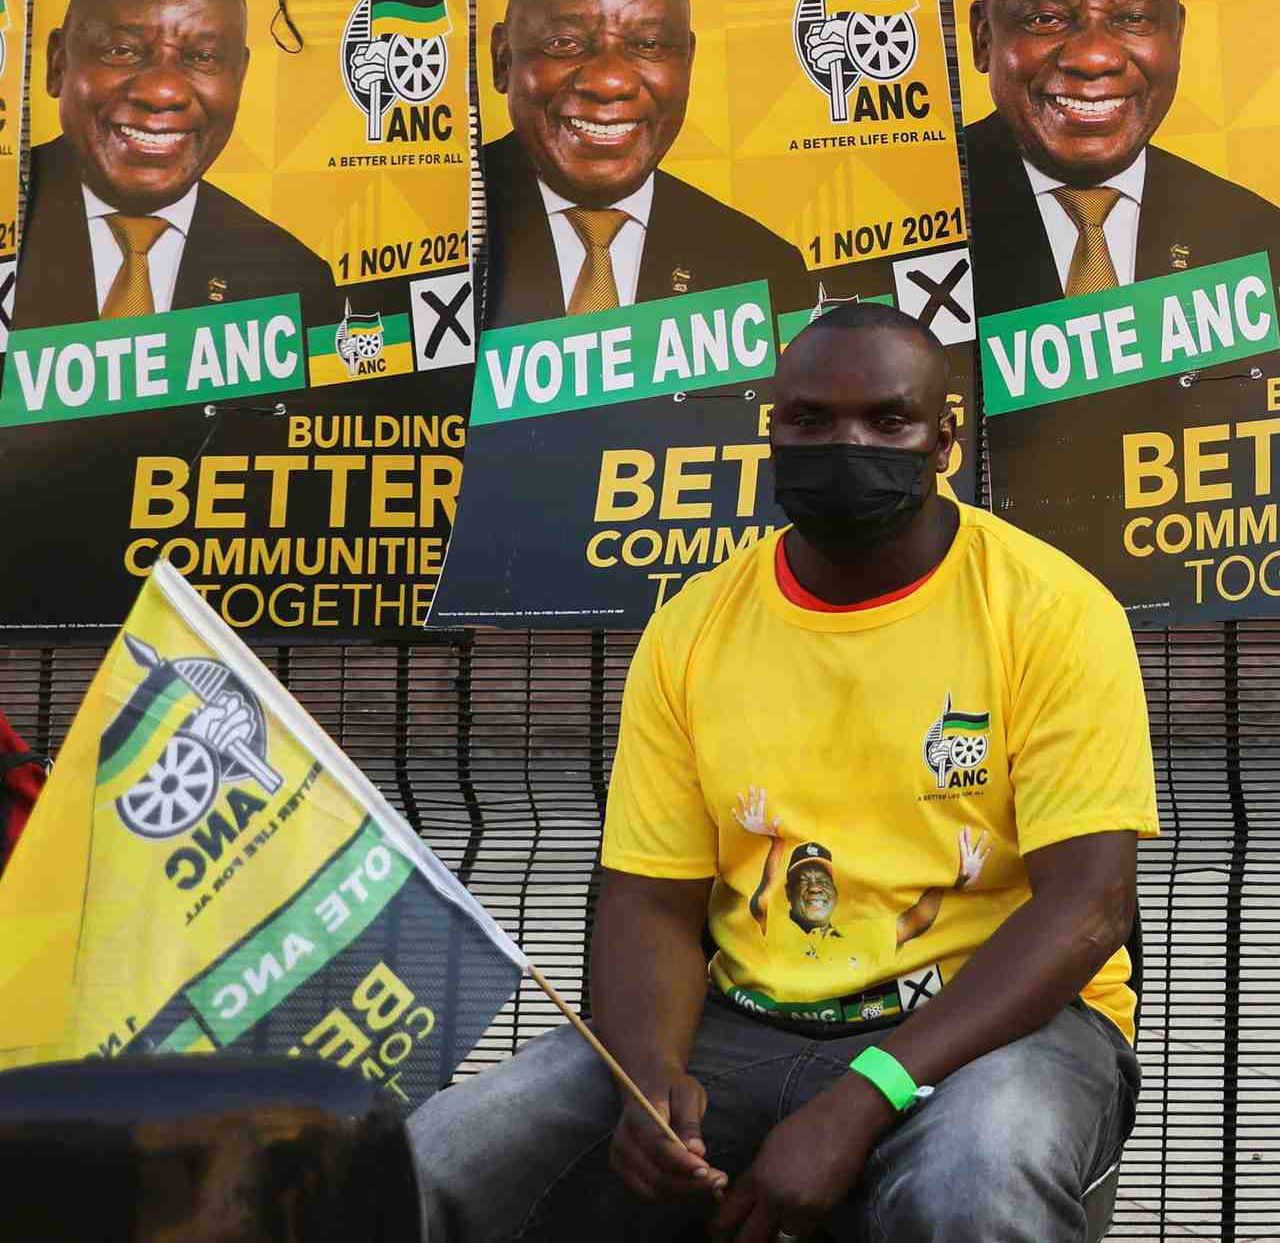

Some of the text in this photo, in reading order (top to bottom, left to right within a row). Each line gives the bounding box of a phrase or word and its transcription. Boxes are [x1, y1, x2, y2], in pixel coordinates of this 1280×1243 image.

[853, 82, 929, 122] ANC
[387, 105, 453, 142] ANC
[790, 131, 946, 150] A BETTER LIFE FOR ALL
[328, 154, 463, 167] A BETTER LIFE FOR ALL
[0, 220, 15, 247] 21
[809, 208, 961, 263] 1 NOV 2021
[339, 230, 469, 279] 1 NOV 2021
[486, 303, 768, 409] VOTE ANC
[987, 275, 1272, 398] VOTE ANC
[14, 315, 298, 411] VOTE ANC
[358, 358, 386, 374] ANC
[288, 415, 466, 448] BUILDING
[129, 456, 465, 529] BETTER
[124, 538, 443, 576] COMMUNITIE
[192, 582, 434, 628] OGETHE
[949, 768, 988, 788] ANC
